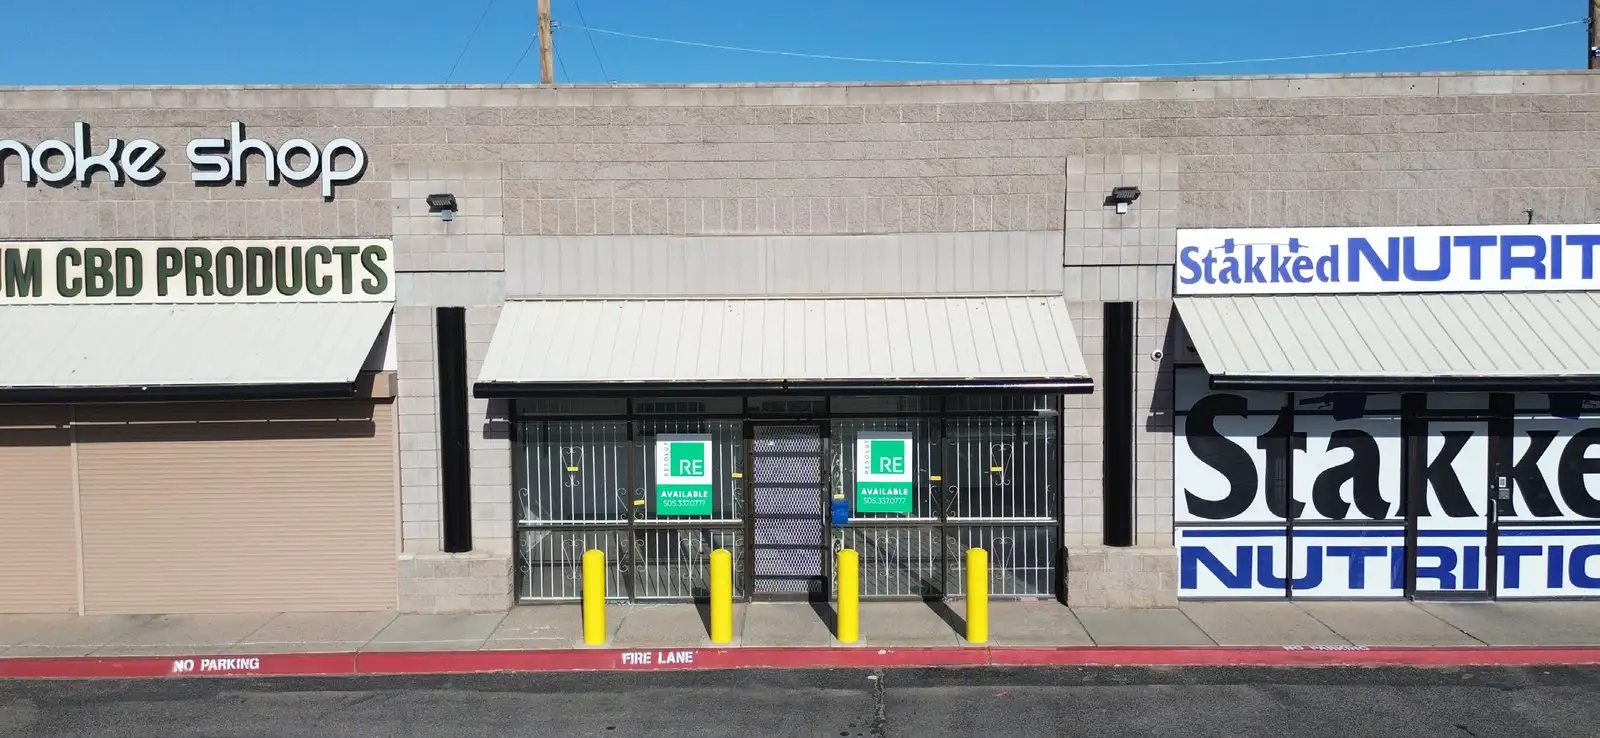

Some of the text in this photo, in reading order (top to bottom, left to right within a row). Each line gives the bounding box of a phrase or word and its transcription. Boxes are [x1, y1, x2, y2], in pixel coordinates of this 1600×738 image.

[186, 121, 366, 198] shop
[1179, 234, 1600, 285] Stakked NUTRIT
[0, 244, 389, 298] M CBD PRODUCTS
[679, 459, 703, 476] RE
[879, 456, 904, 473] RE
[661, 490, 709, 498] AVAILABLE
[861, 487, 909, 496] AVAILABLE
[173, 657, 260, 673] NO PARKING
[621, 651, 694, 665] FIRE LANE
